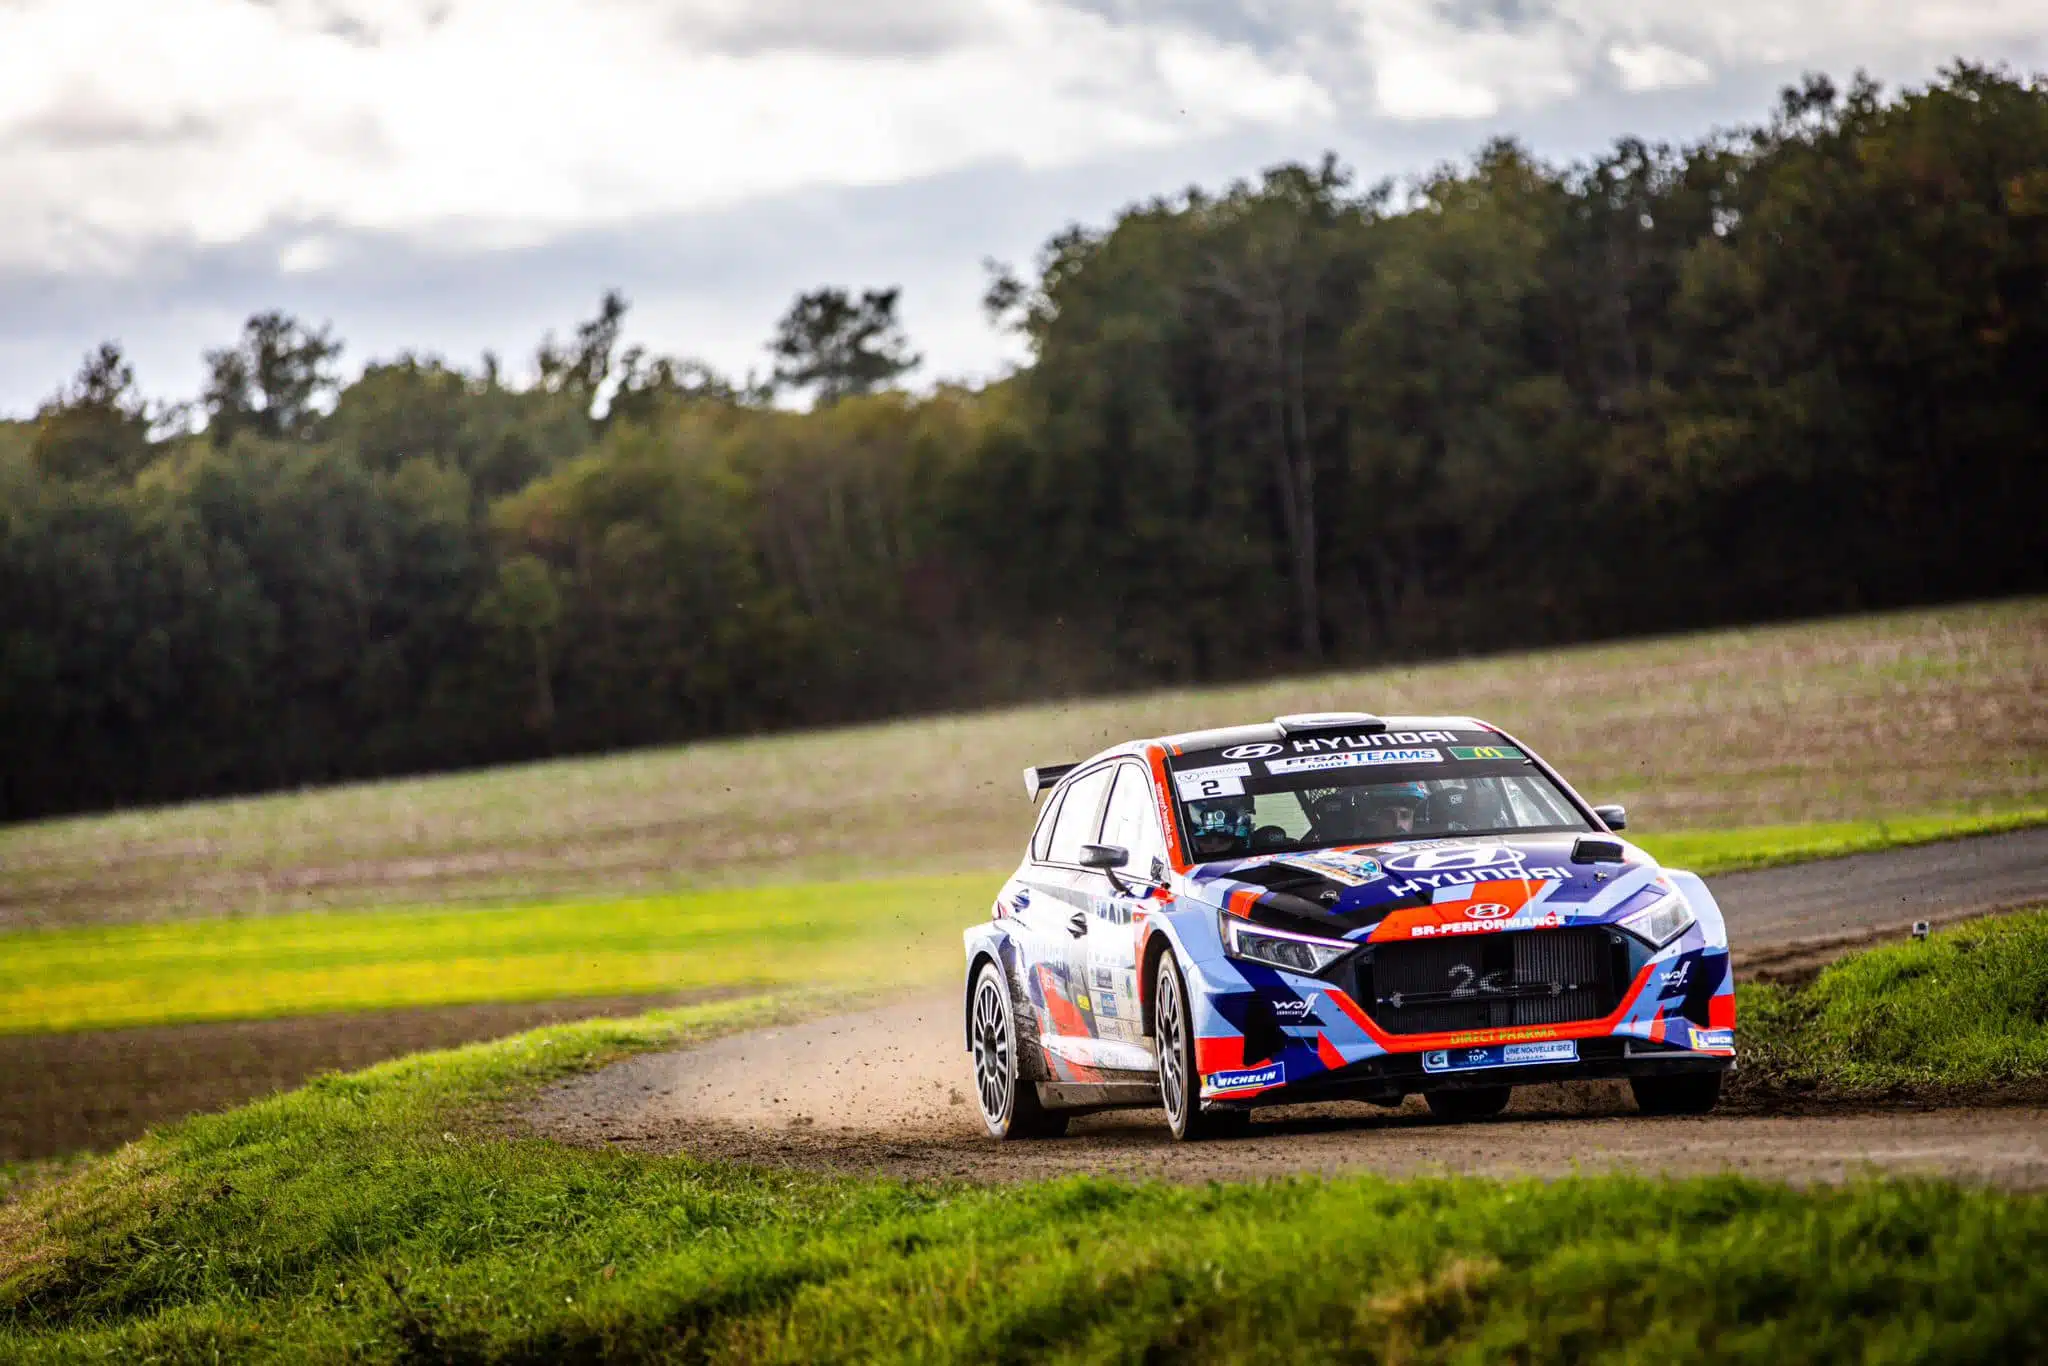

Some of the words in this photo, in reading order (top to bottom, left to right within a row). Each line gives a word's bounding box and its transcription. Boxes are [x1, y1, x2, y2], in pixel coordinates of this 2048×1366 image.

[1293, 731, 1459, 752] HYUNDAI
[1352, 750, 1435, 763] TEAMS
[1200, 779, 1222, 796] 2
[1387, 866, 1576, 897] HYUNDAI
[1411, 914, 1567, 937] BR-PERFORMANCE
[1451, 1032, 1494, 1045] DIRECT
[1499, 1028, 1557, 1041] PHARMA
[1468, 1053, 1486, 1062] TOP
[1505, 1046, 1520, 1055] UNE
[1521, 1044, 1555, 1054] NOUVELLE
[1217, 1070, 1276, 1087] MICHELIN
